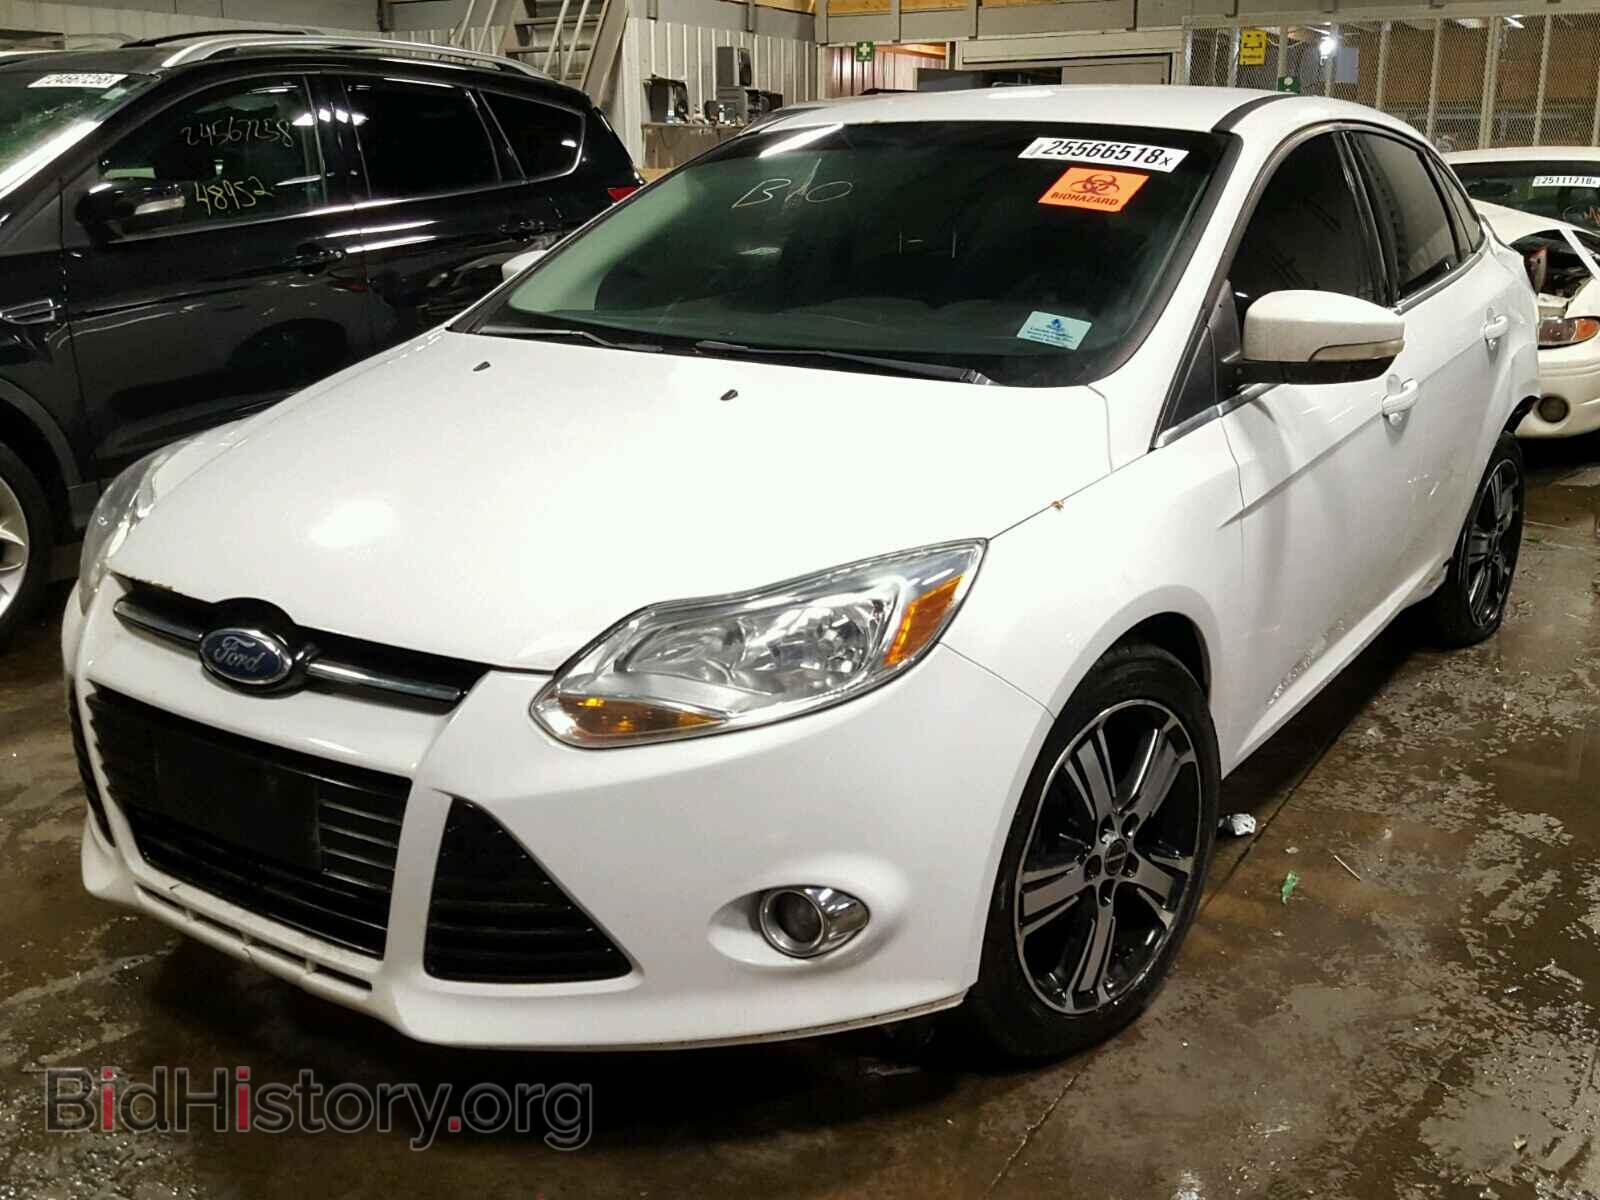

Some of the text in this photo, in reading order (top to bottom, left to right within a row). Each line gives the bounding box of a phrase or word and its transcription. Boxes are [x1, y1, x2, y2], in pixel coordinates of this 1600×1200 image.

[193, 175, 274, 217] 48952
[1051, 191, 1121, 208] BIOHAZARD
[213, 635, 265, 671] Ford
